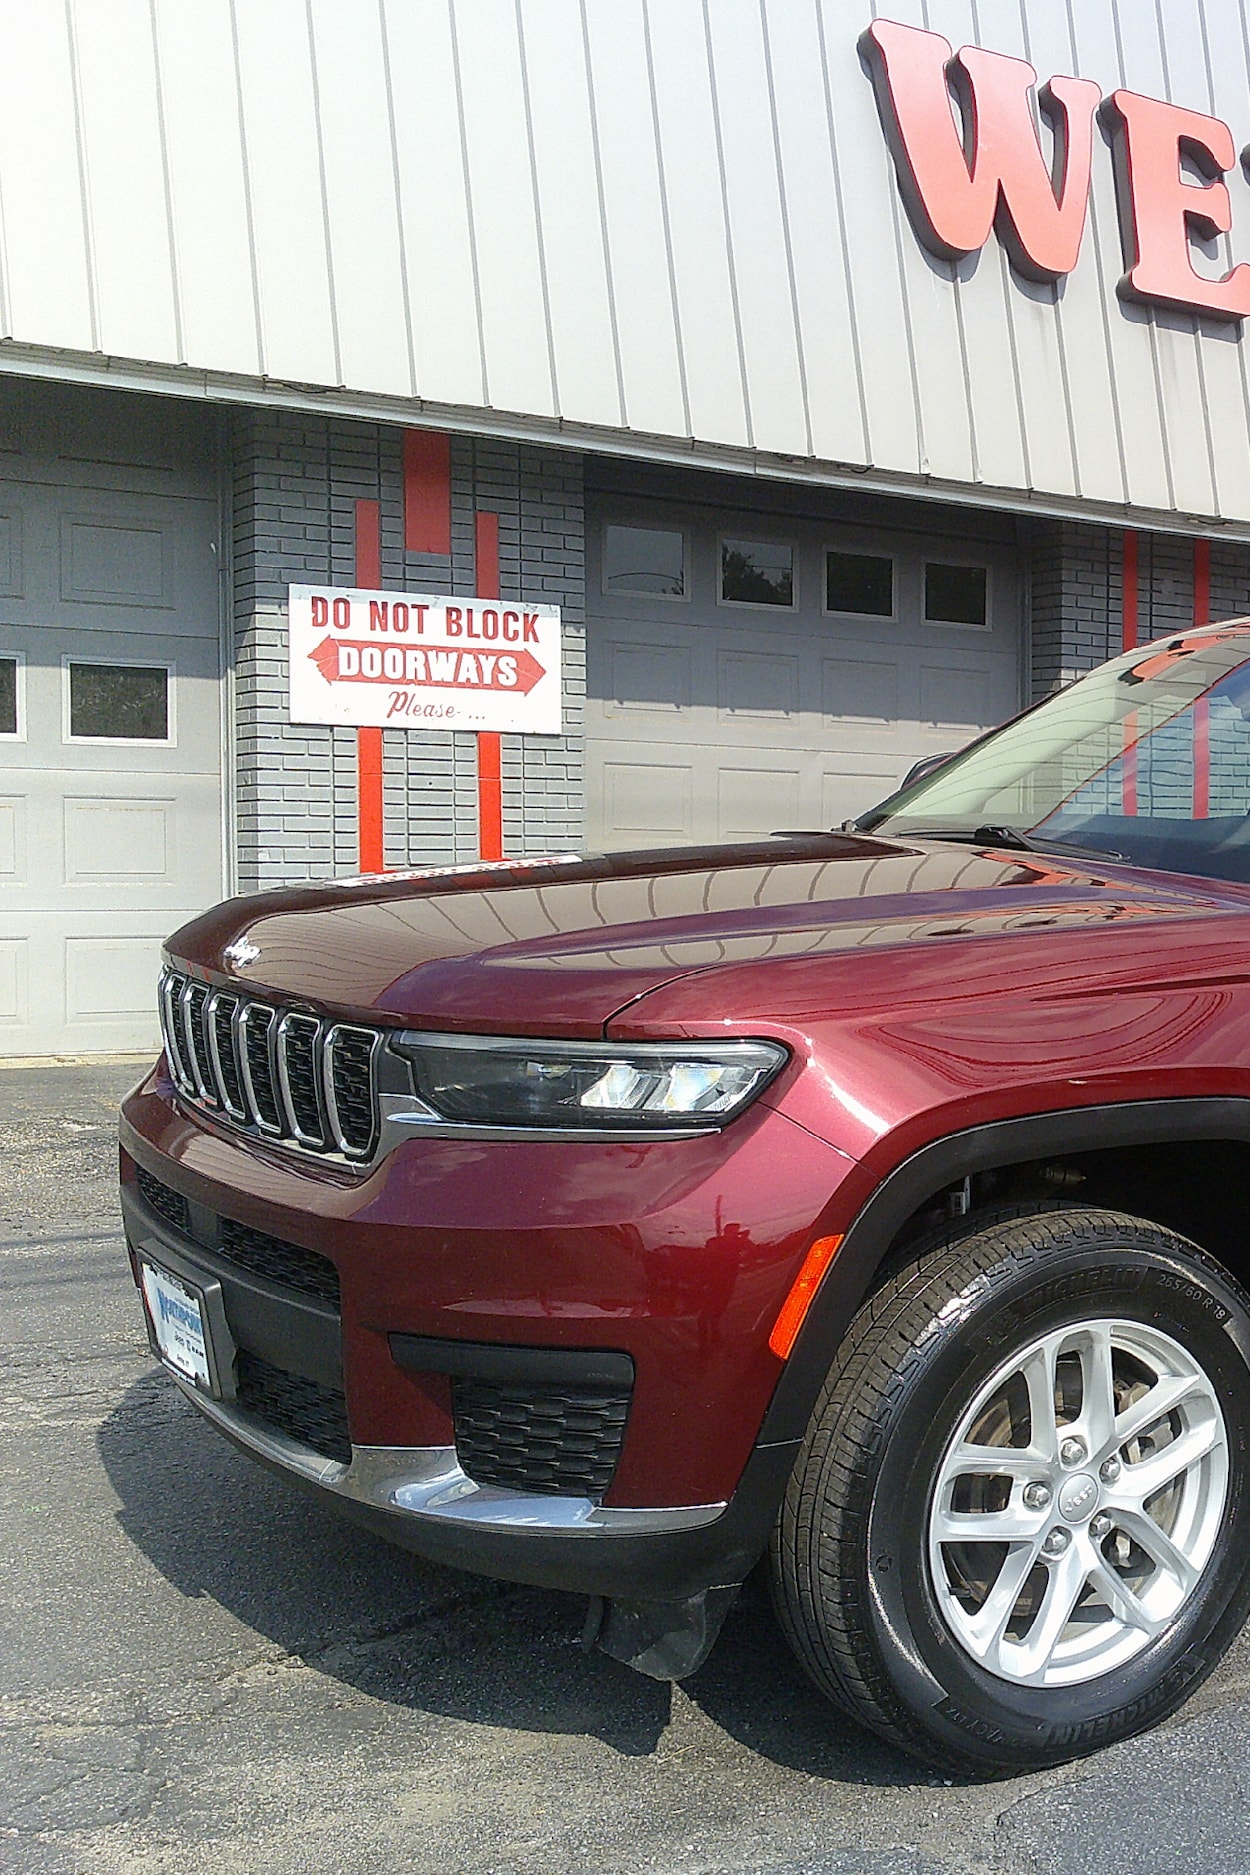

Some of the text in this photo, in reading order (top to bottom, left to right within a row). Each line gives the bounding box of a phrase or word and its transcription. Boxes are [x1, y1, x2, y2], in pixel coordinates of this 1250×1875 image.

[311, 595, 540, 643] DO NOT BLOCK
[337, 645, 518, 687] DOORWAYS
[386, 690, 457, 719] Please
[1155, 1273, 1203, 1301] 265/60
